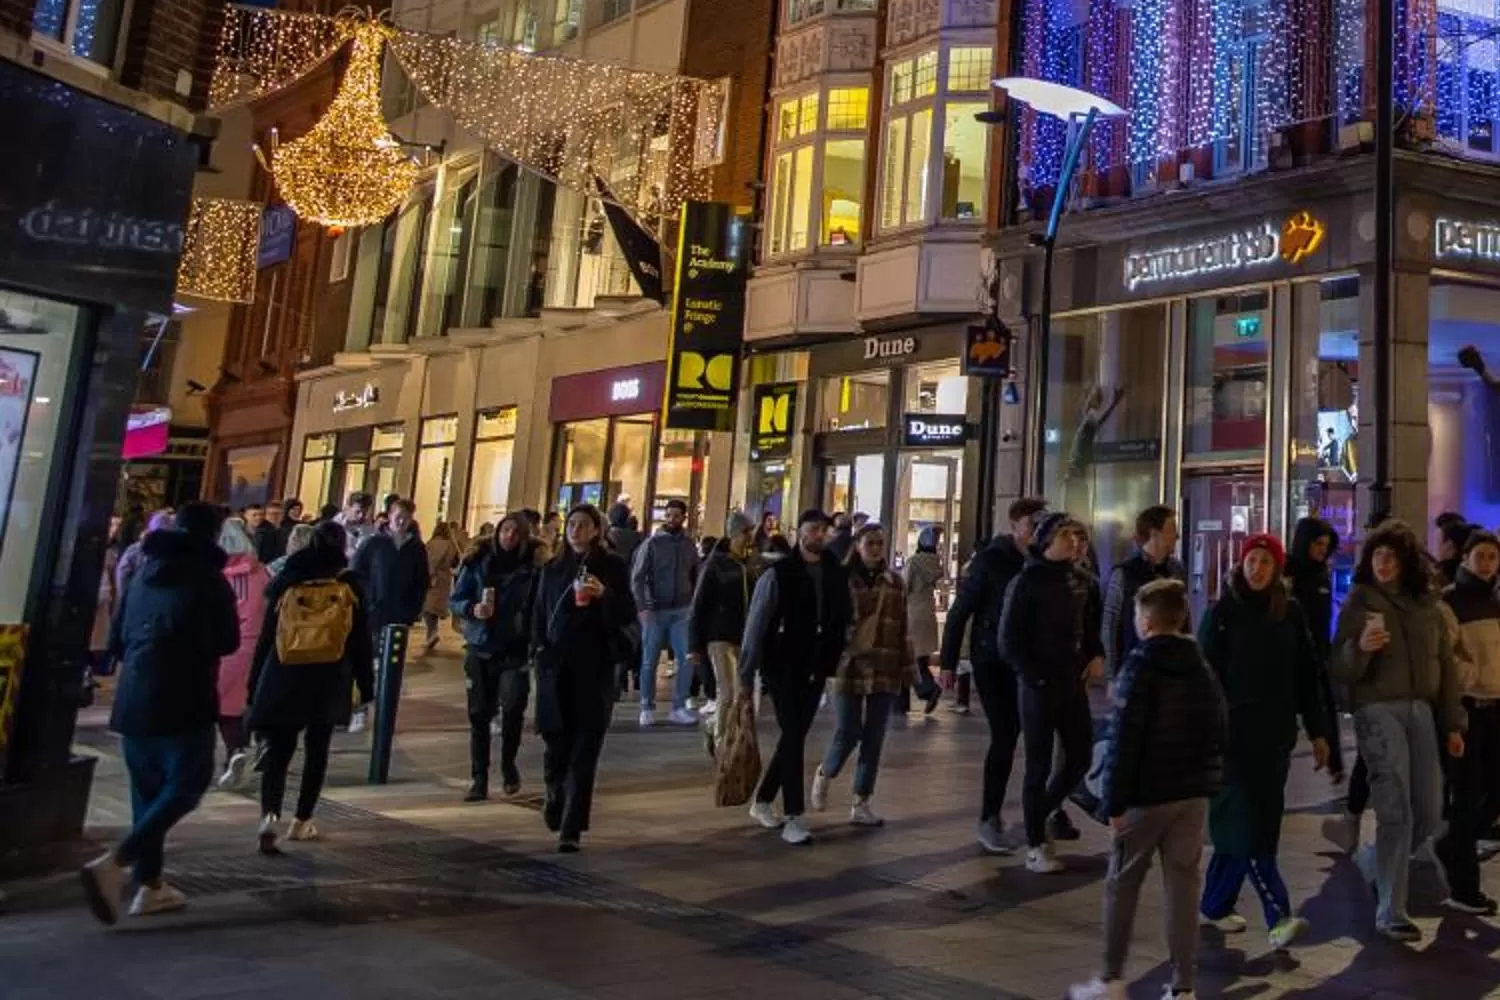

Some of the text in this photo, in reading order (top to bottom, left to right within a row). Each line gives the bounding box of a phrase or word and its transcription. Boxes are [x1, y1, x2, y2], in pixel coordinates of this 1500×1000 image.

[690, 243, 711, 257] The
[688, 257, 736, 274] Academy
[1123, 233, 1240, 291] permanent
[684, 298, 723, 310] Lunatic
[684, 310, 716, 325] Fringe
[864, 336, 915, 360] Dune
[909, 420, 963, 436] Dune
